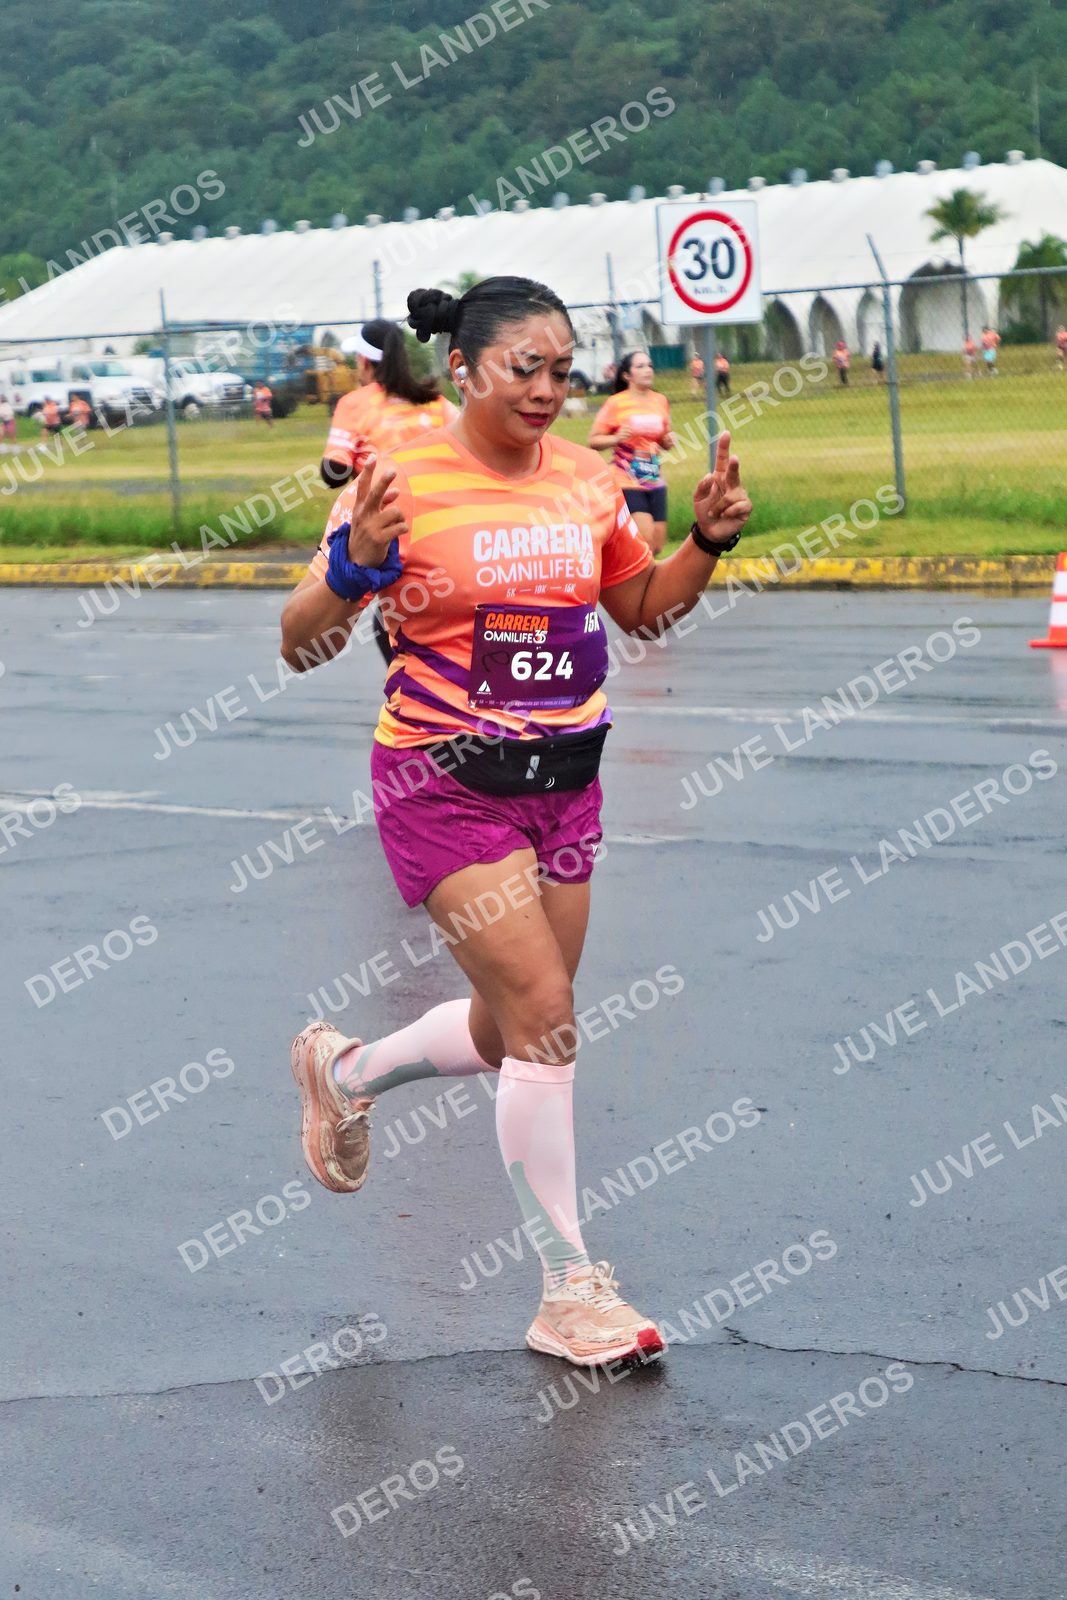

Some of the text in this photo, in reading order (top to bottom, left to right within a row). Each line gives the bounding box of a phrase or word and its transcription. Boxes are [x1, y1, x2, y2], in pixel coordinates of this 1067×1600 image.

[683, 237, 735, 281] 30
[473, 523, 594, 563] CARRERA
[476, 558, 575, 587] OMNILIFE
[484, 612, 549, 632] CARRERA
[484, 630, 533, 644] OMNILIFE
[511, 651, 574, 681] 624
